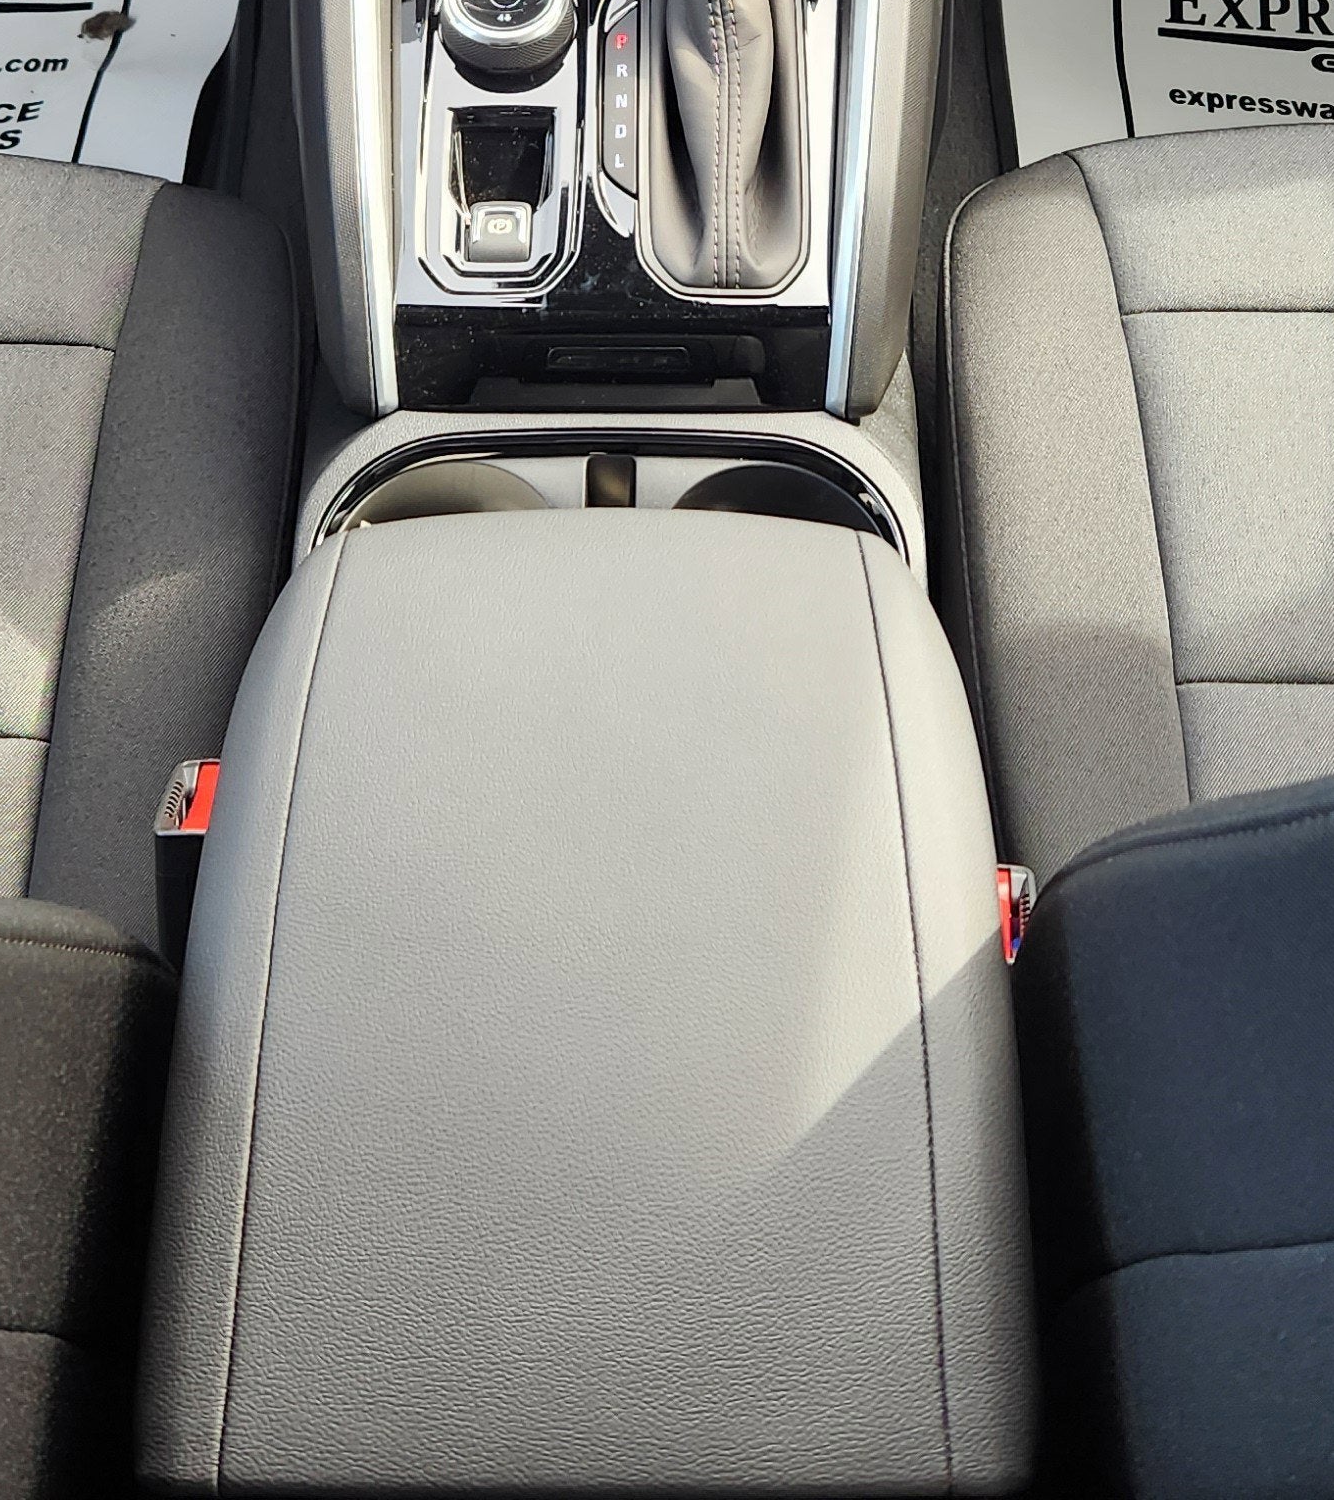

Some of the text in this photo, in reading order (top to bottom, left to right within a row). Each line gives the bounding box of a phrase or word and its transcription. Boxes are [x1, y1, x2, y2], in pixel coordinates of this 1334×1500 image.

[615, 33, 628, 49] P
[616, 64, 628, 78] R
[615, 94, 628, 108] N
[615, 124, 627, 139] D
[615, 153, 625, 168] L
